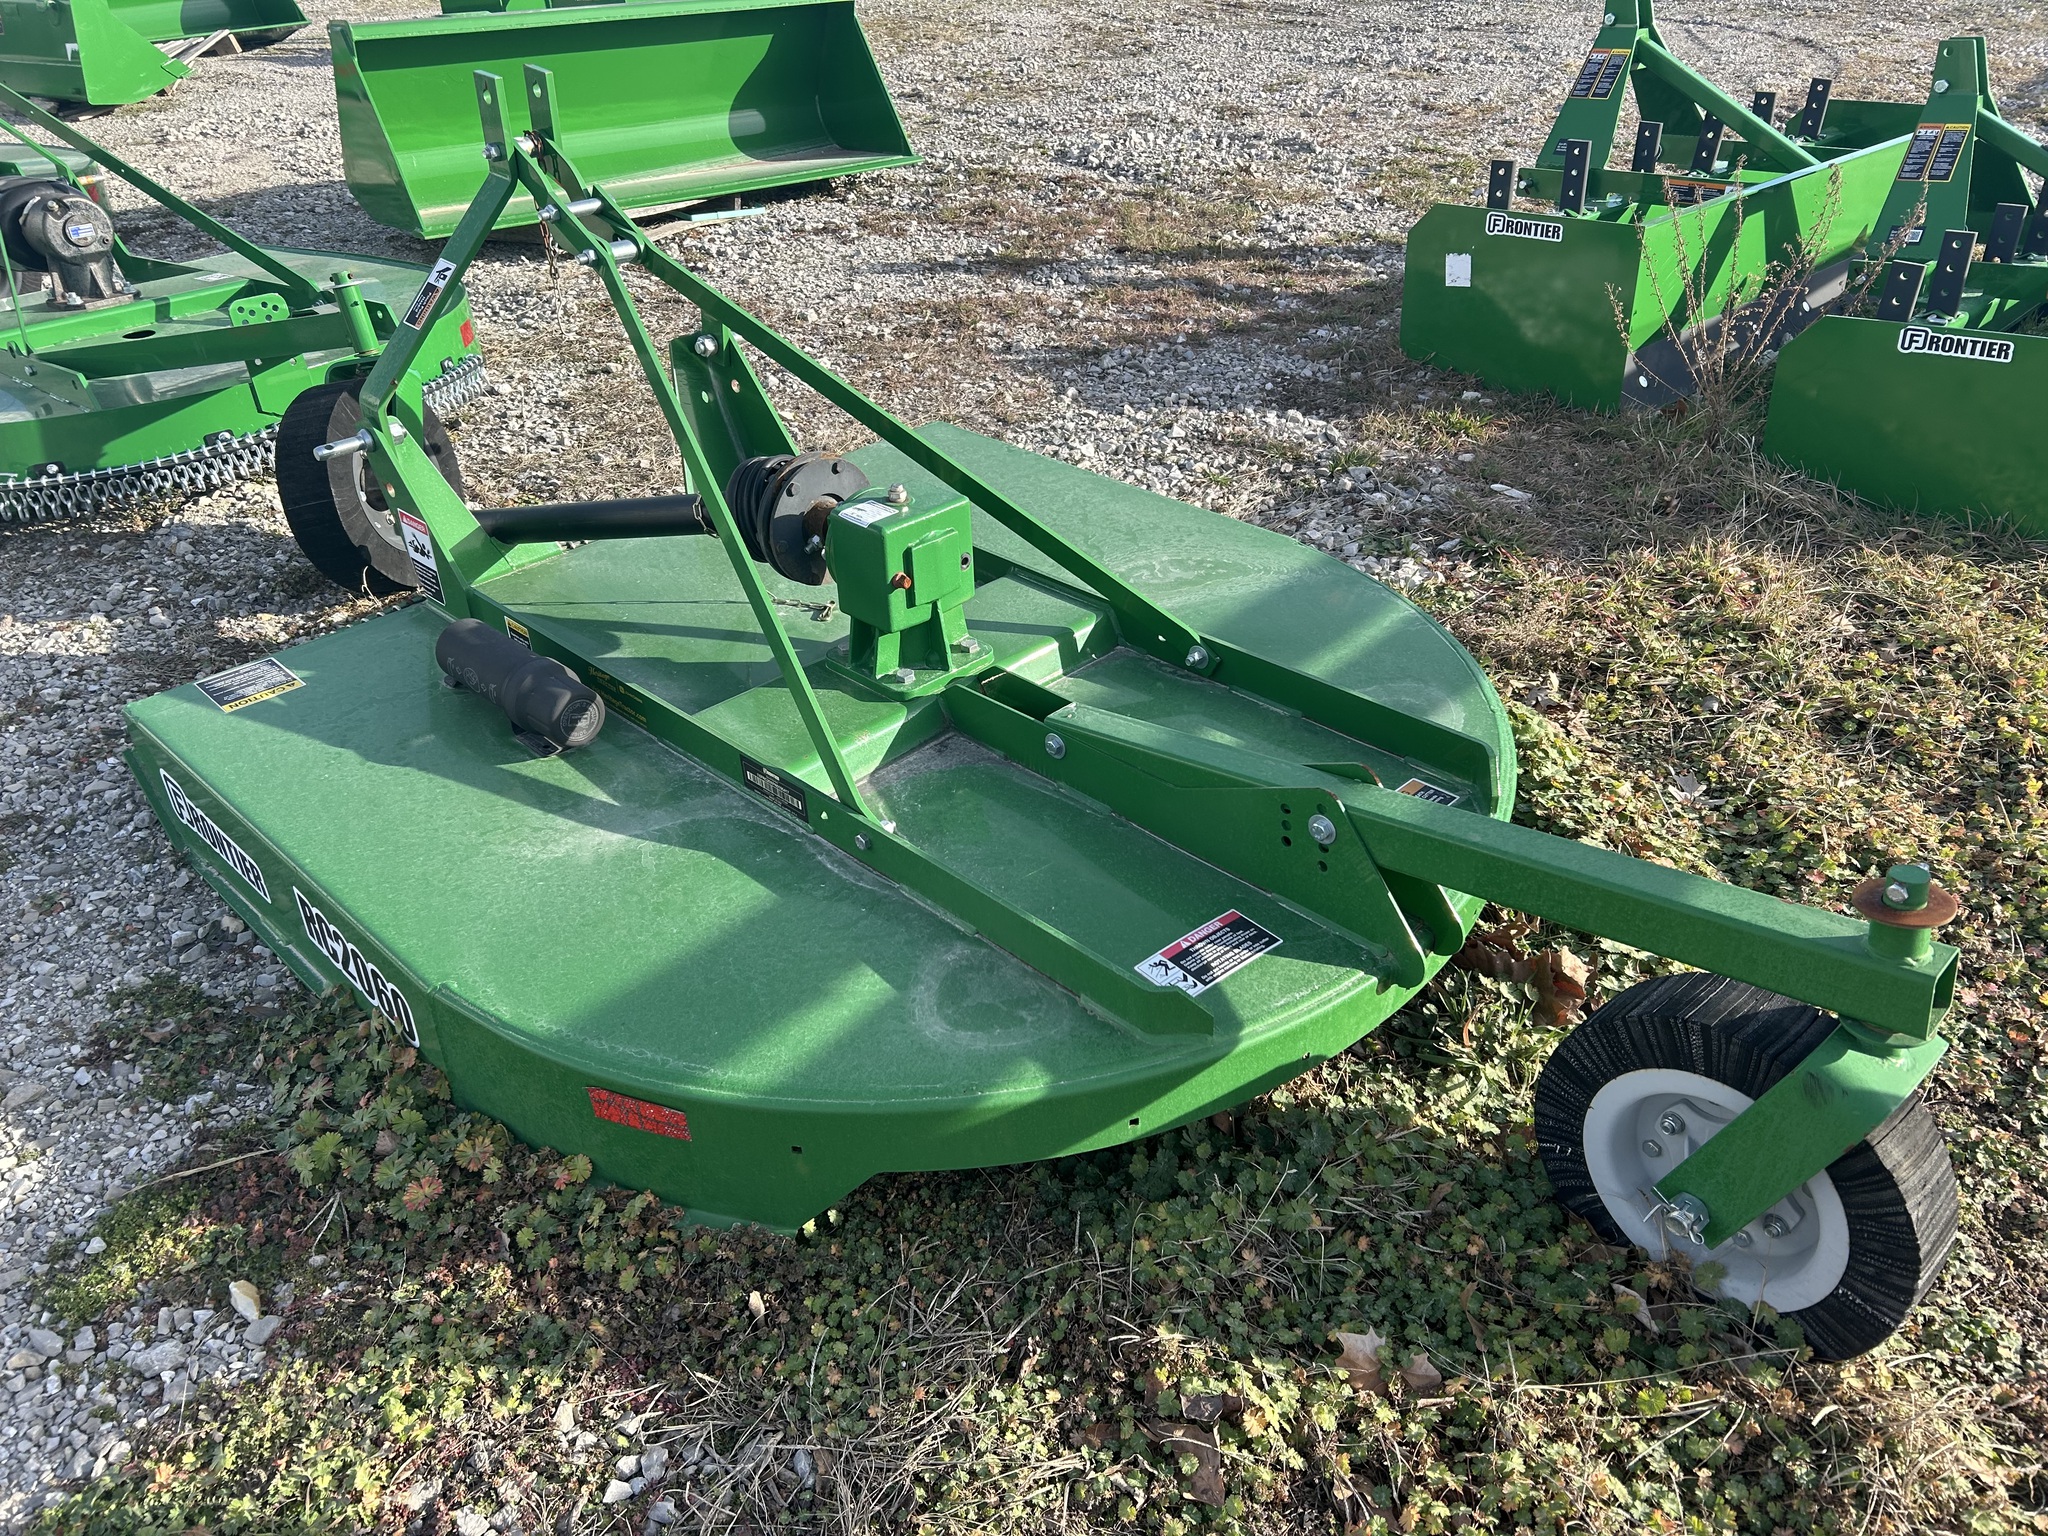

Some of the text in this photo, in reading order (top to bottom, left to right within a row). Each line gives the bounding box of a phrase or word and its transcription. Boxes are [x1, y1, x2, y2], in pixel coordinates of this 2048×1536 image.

[1486, 213, 1561, 240] FRONTIER
[1900, 327, 2012, 360] FRONTIER
[228, 685, 287, 710] CAUTION
[164, 774, 268, 899] FRONTIER
[1187, 920, 1224, 944] DANGER
[294, 888, 417, 1044] RC2060
